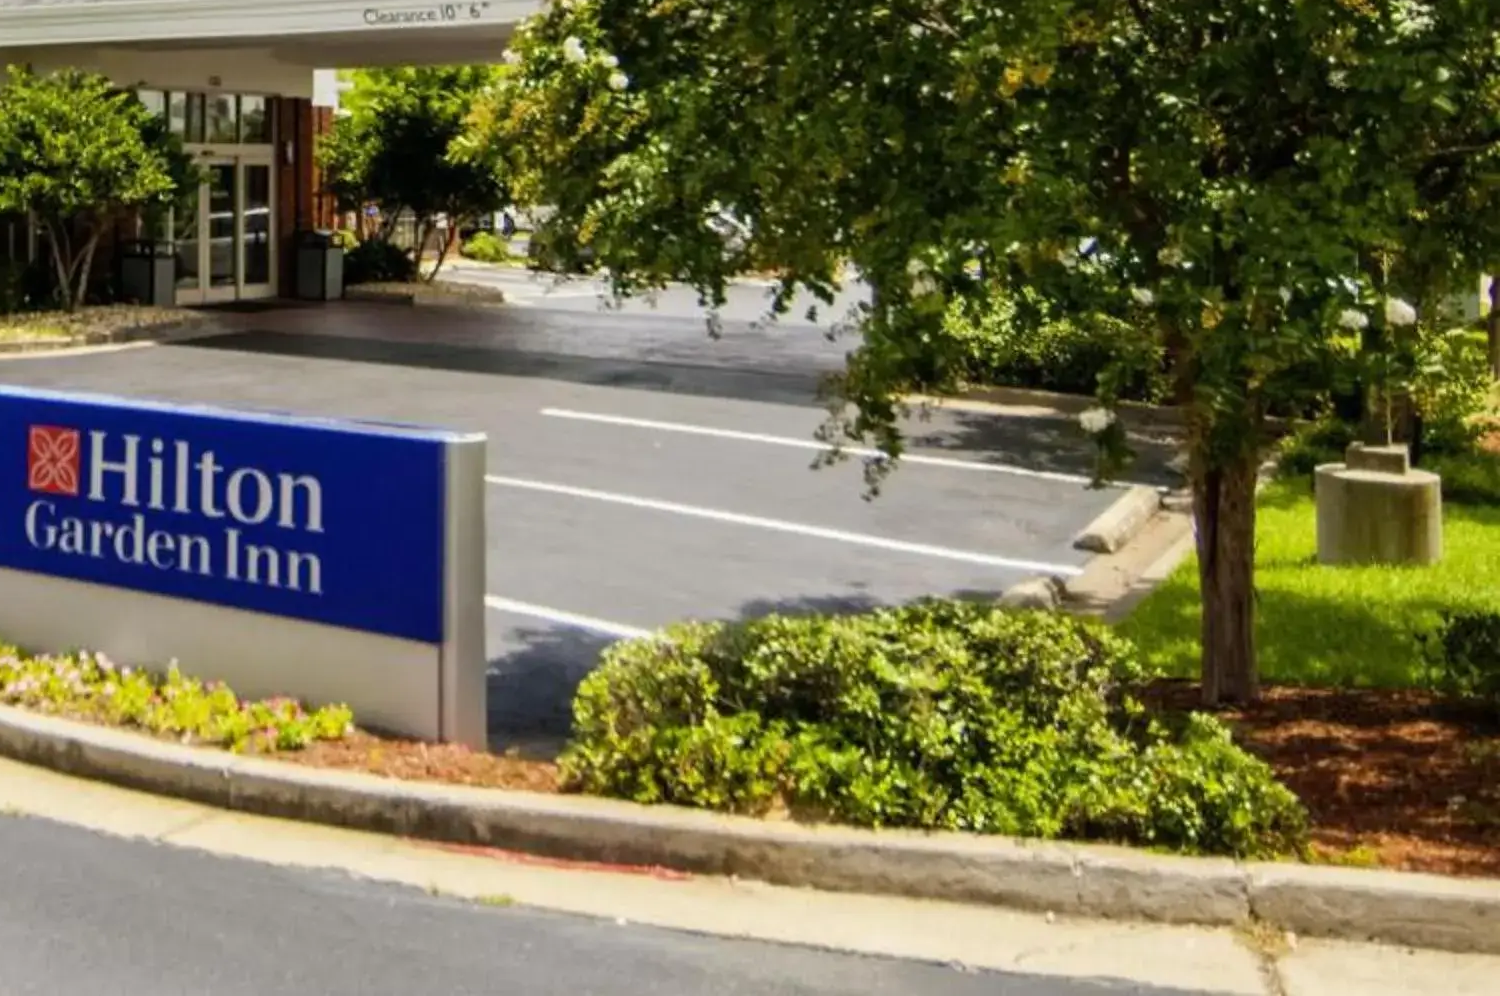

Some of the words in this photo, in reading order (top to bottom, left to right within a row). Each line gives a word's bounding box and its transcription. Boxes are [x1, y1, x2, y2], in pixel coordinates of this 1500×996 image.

[87, 429, 325, 533] Hilton
[24, 499, 214, 576] Garden
[223, 526, 324, 596] Inn
